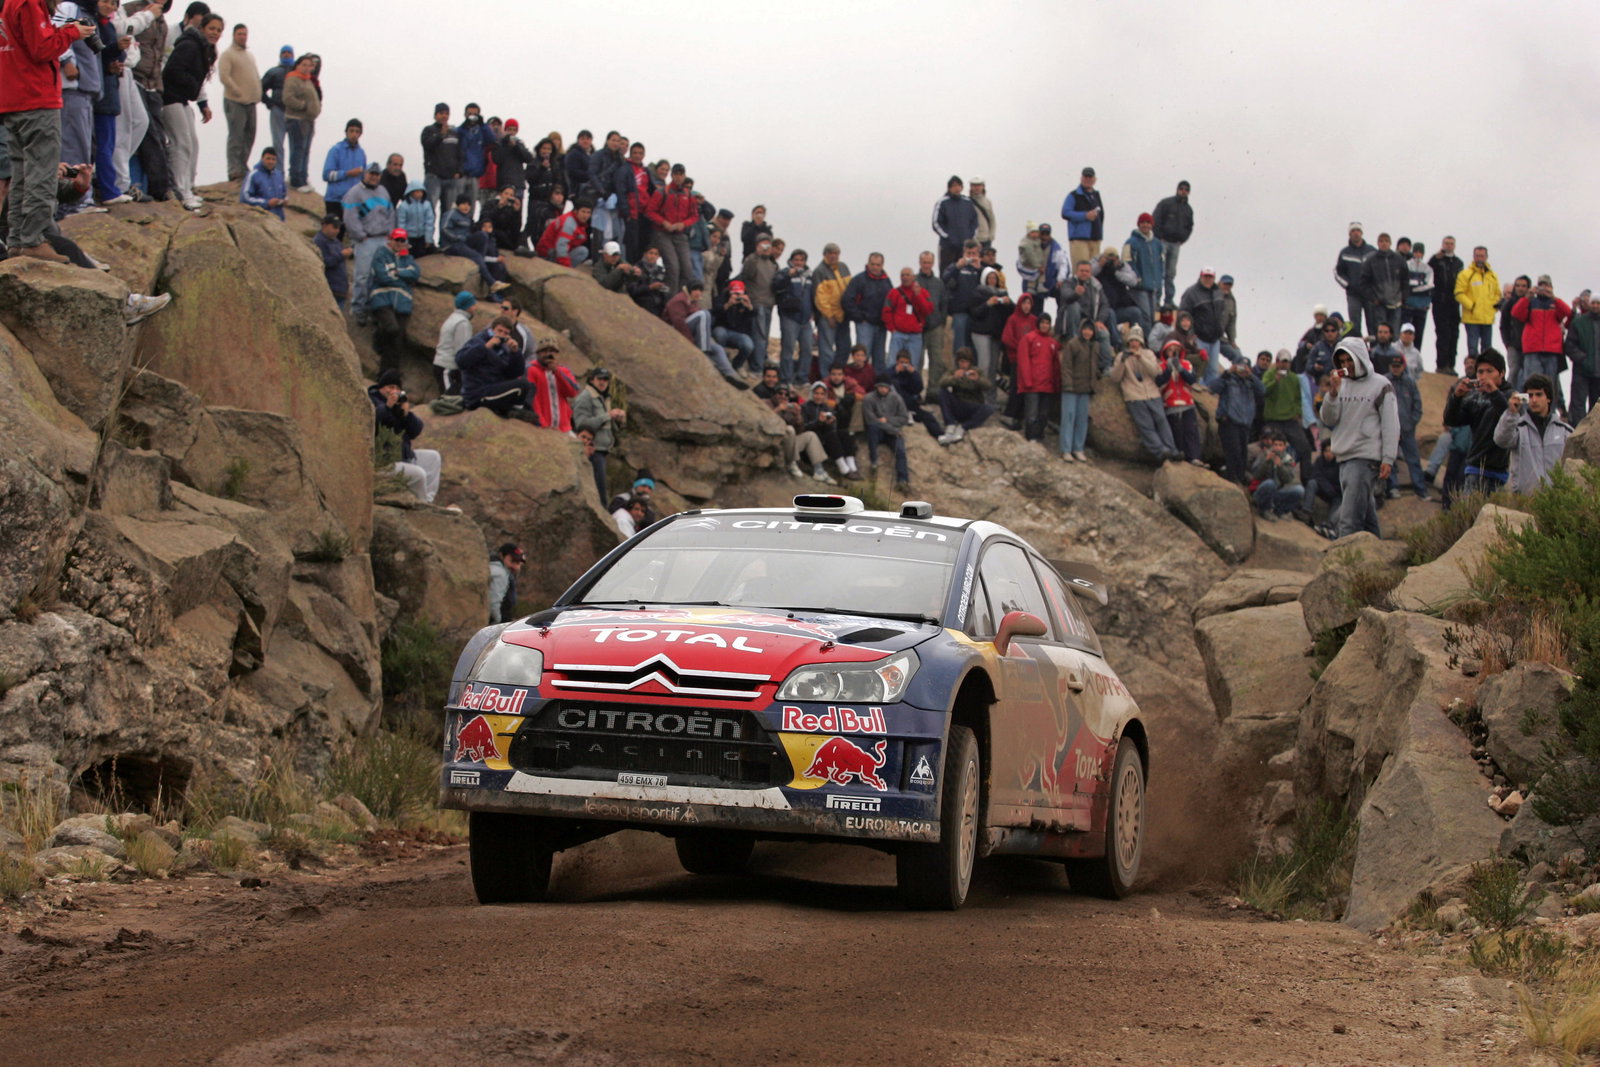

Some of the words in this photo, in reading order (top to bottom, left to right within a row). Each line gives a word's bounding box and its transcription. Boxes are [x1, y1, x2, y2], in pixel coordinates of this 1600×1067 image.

[590, 628, 764, 654] TOTAL
[480, 688, 528, 714] Bull
[782, 705, 839, 732] Red
[838, 707, 887, 734] Bull
[450, 770, 481, 786] PIRELLI
[620, 775, 634, 785] 459
[635, 776, 653, 786] EMX
[655, 778, 664, 787] 78
[826, 794, 882, 812] PIRELLI
[632, 806, 680, 821] sportif
[845, 816, 932, 834] EURODATACAR
